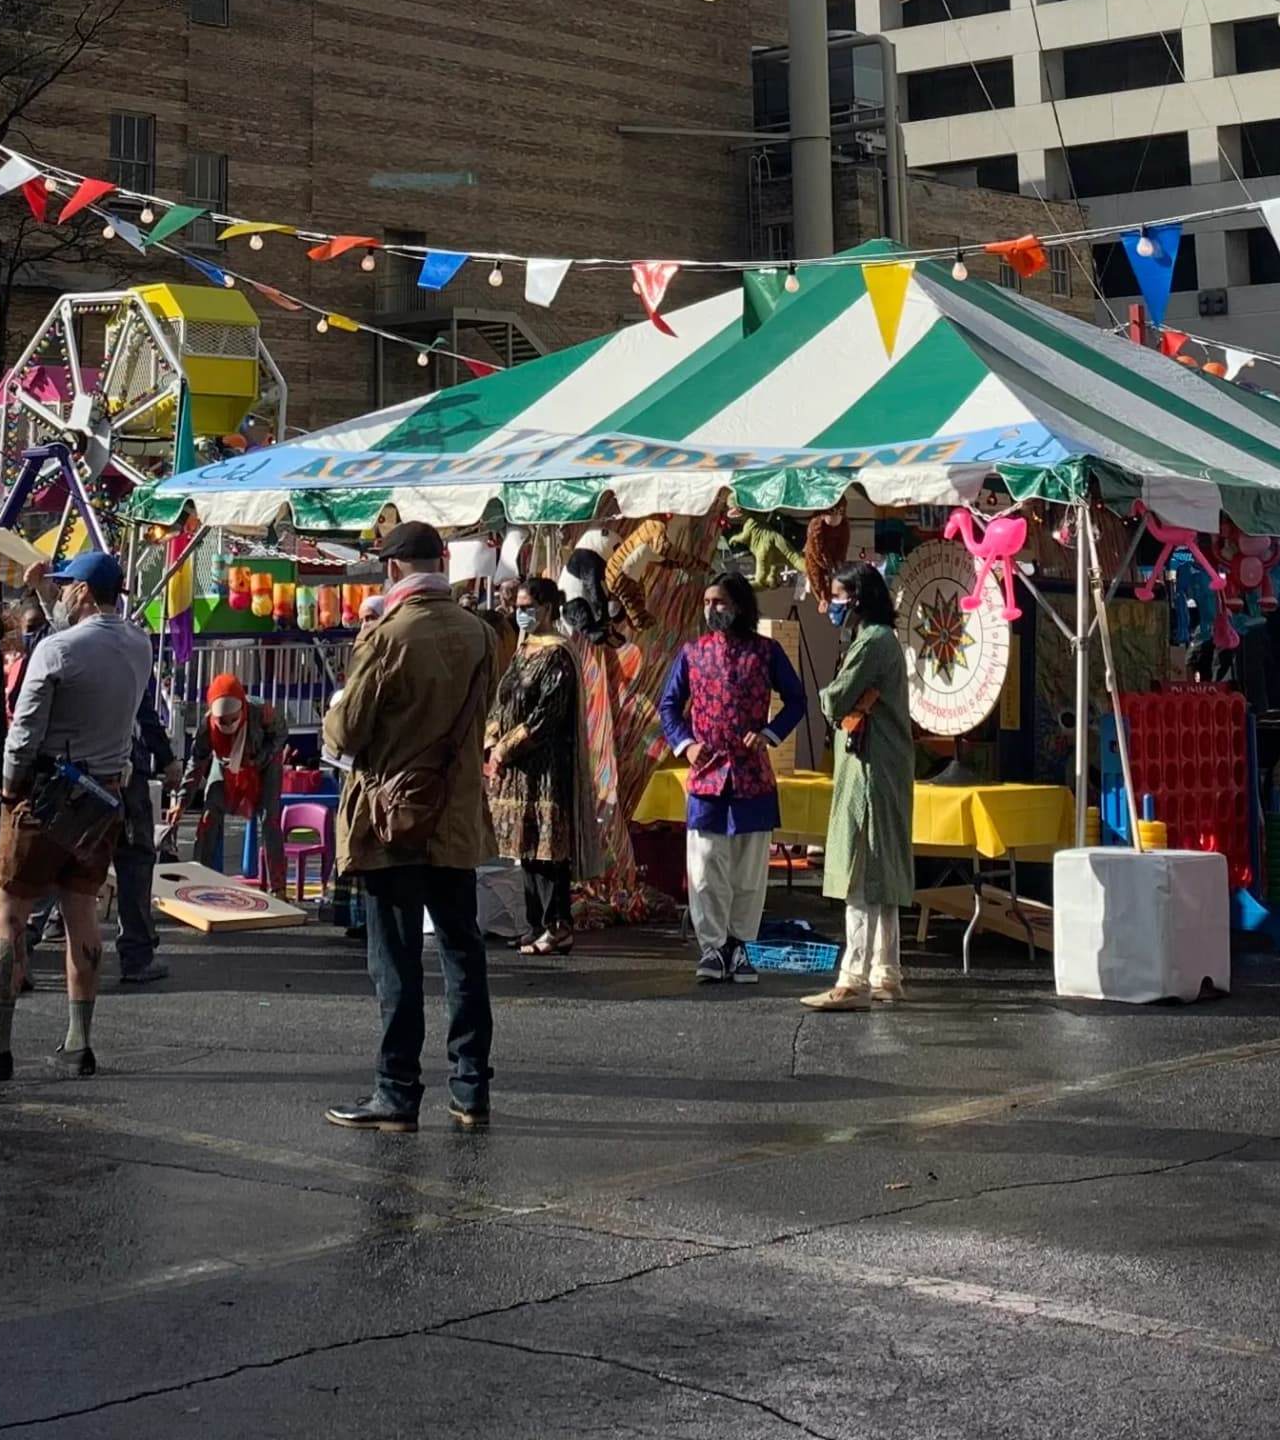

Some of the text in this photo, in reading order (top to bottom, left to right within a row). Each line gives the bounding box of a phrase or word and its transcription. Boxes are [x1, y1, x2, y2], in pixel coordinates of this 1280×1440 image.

[198, 458, 272, 483] Eid
[572, 439, 753, 469] KIDS
[972, 435, 1054, 462] Eid
